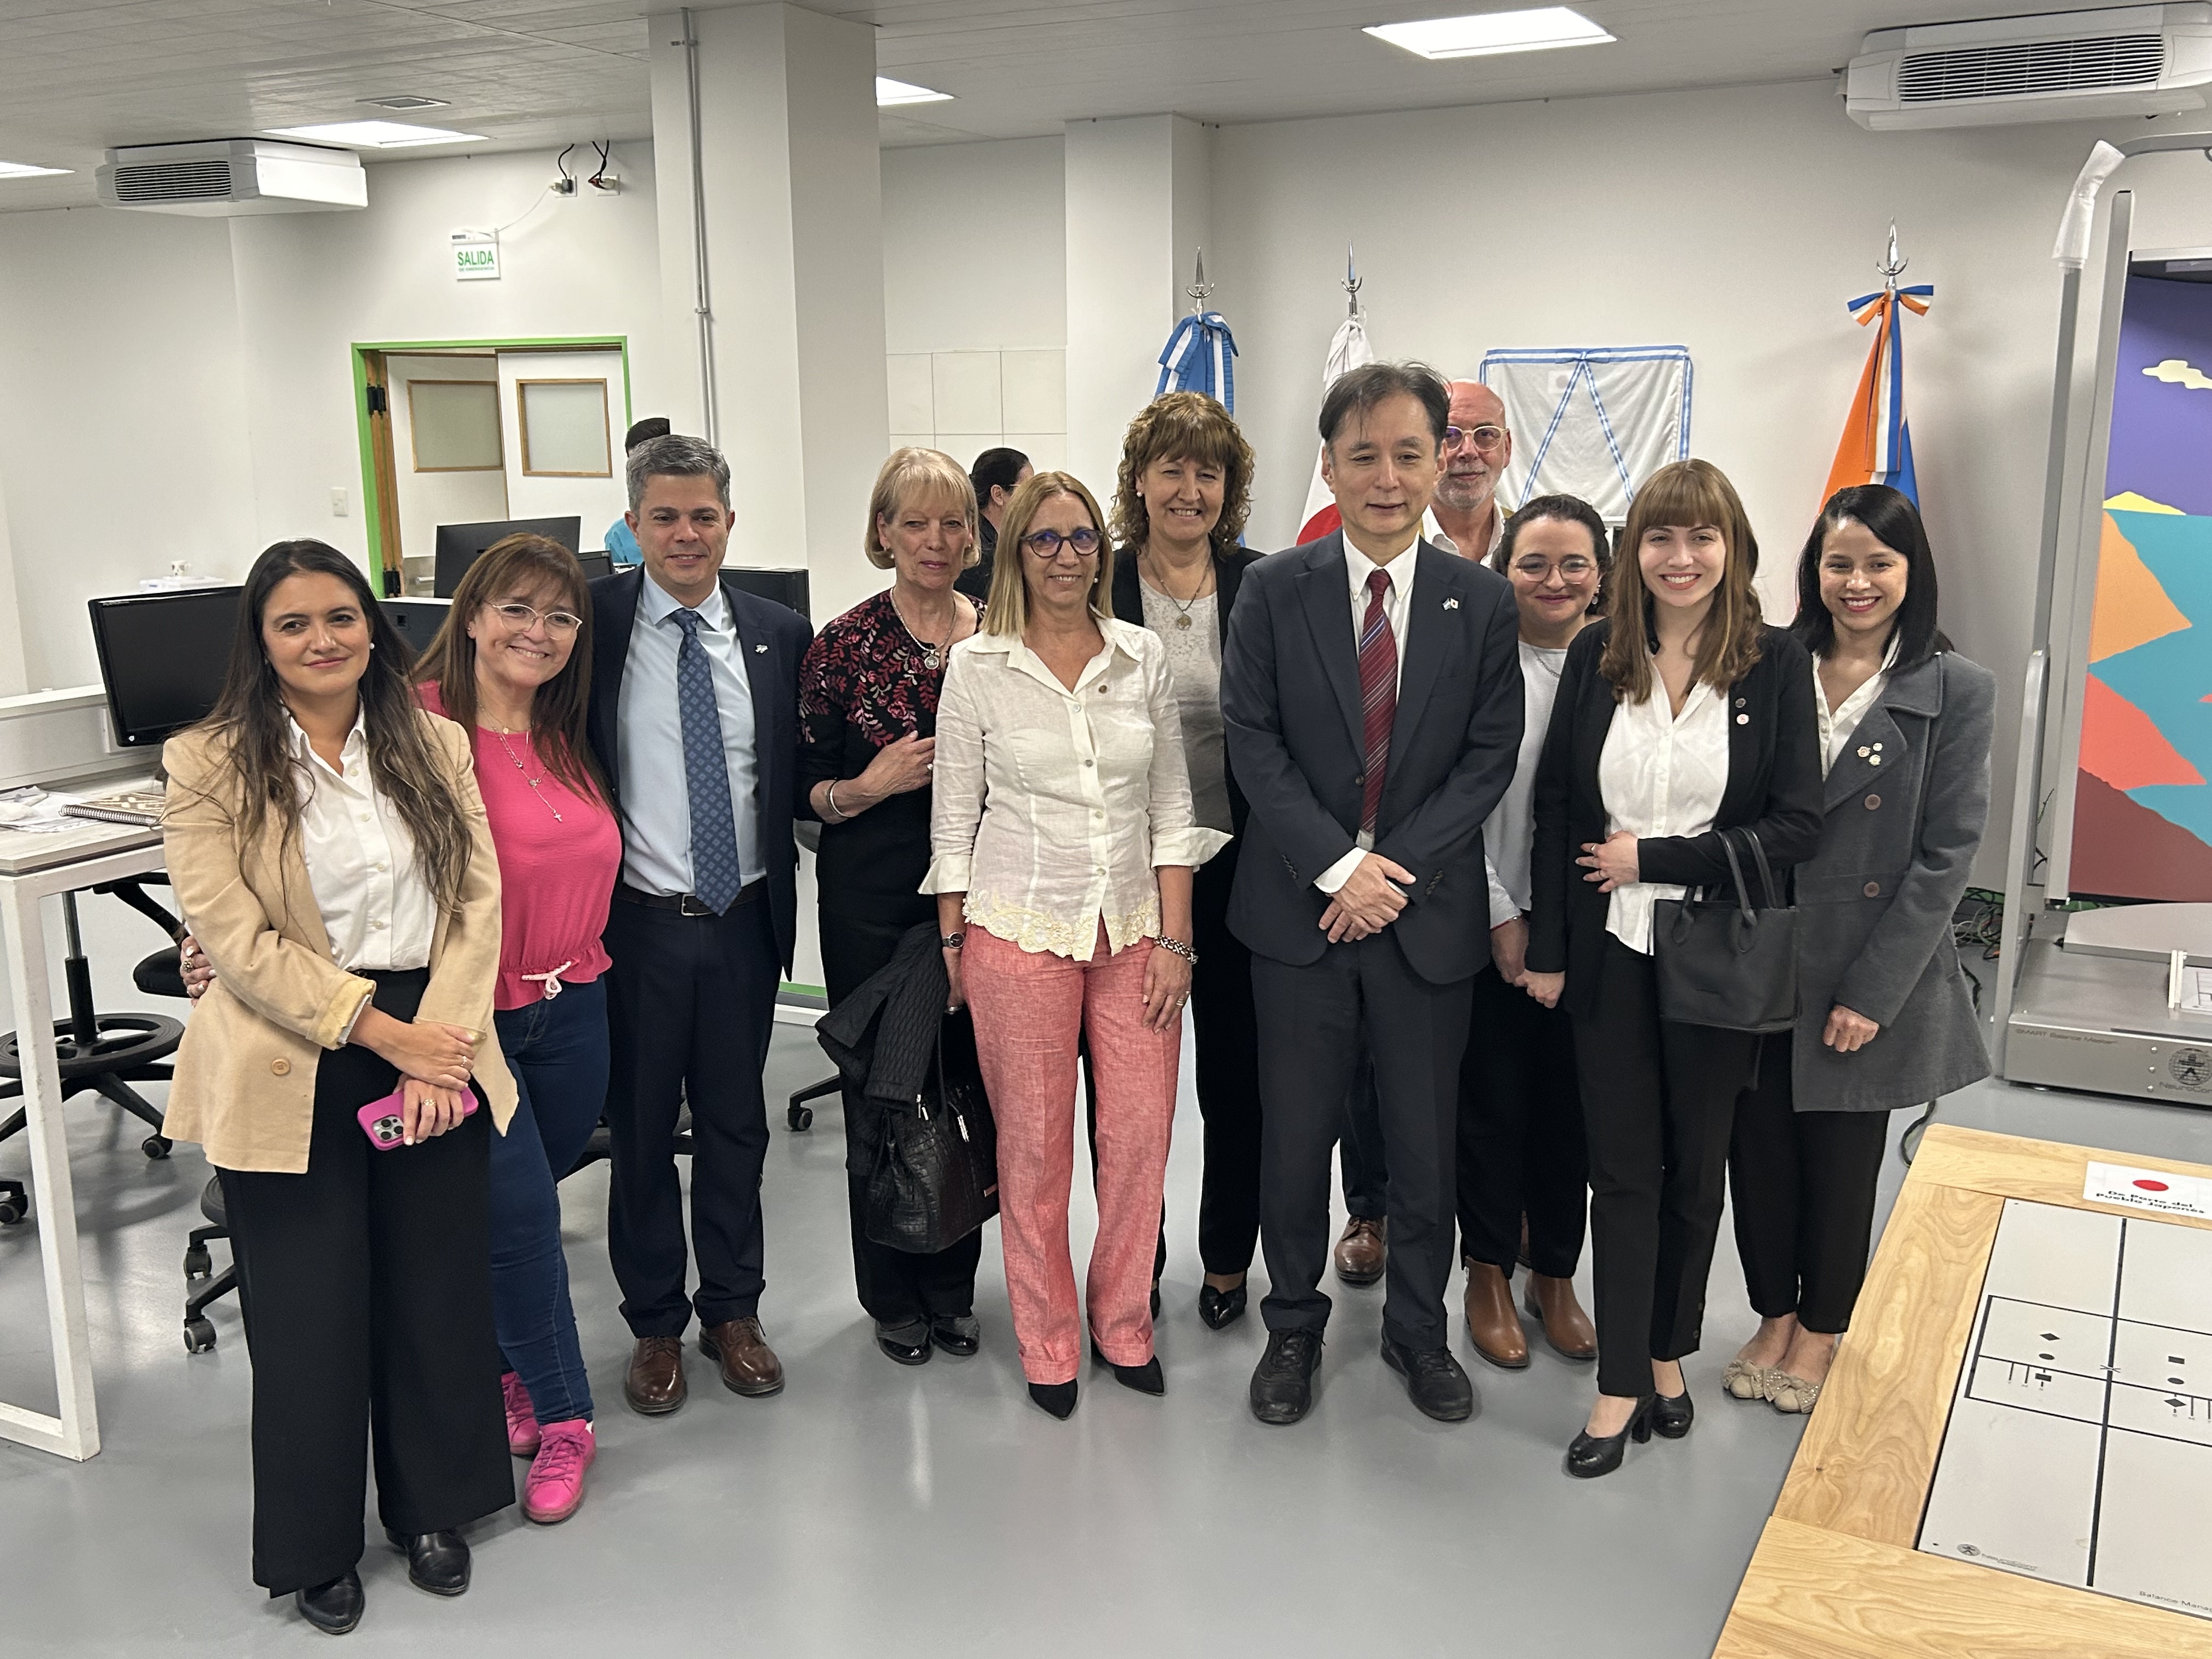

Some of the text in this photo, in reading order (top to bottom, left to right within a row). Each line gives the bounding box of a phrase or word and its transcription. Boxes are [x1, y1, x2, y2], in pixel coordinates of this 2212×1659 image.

[458, 250, 494, 266] SALIDA
[2131, 1194, 2167, 1204] Parte
[2140, 1590, 2179, 1604] Balance
